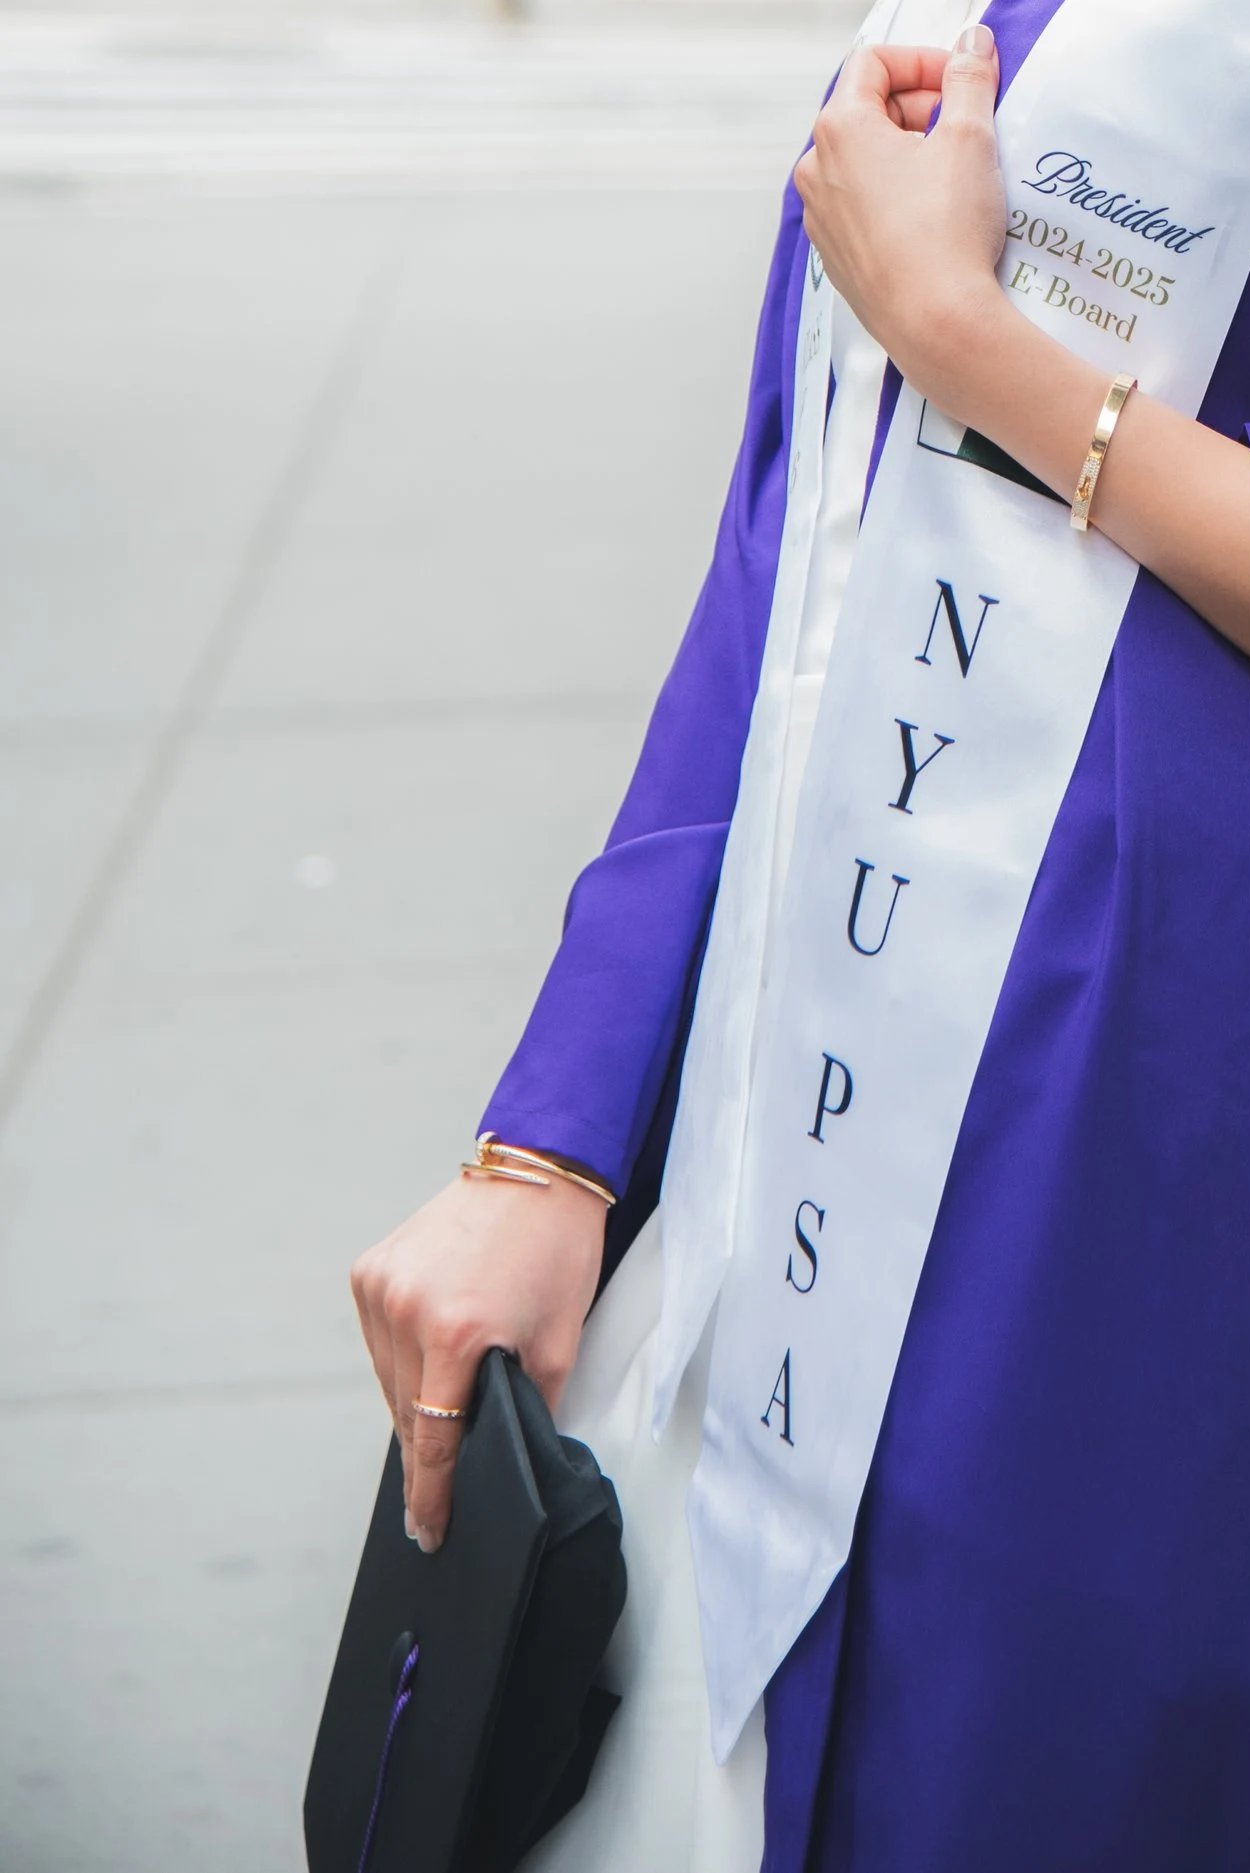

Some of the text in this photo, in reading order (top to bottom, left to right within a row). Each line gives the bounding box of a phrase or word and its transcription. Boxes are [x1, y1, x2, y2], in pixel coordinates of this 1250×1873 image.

[1021, 151, 1216, 254] President
[1005, 209, 1176, 306] 2024-2025
[1007, 260, 1138, 344] E-Board
[760, 578, 1000, 1447] NYU PSA
